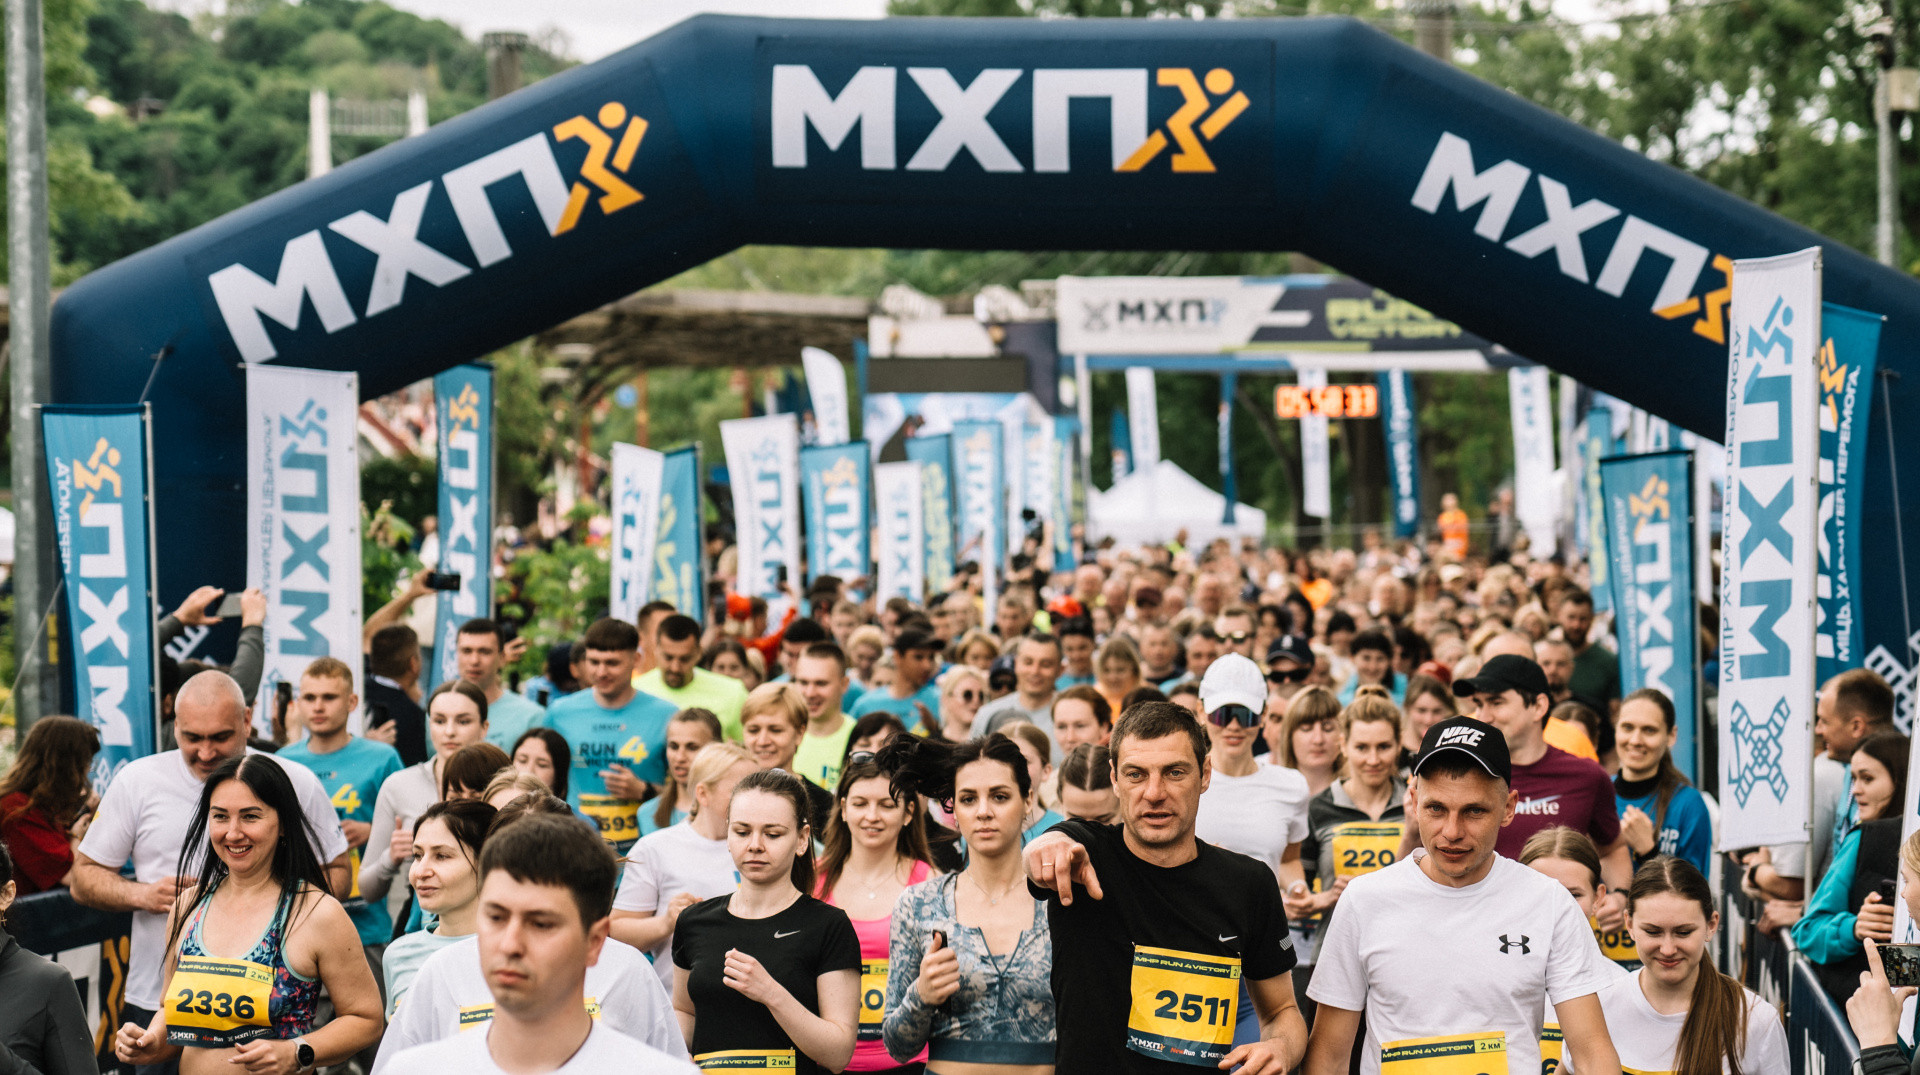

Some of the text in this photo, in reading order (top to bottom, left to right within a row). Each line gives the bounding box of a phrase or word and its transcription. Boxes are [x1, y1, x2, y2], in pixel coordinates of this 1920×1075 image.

[772, 65, 1148, 172] МХП
[1410, 131, 1710, 313] МХП
[209, 133, 572, 362] МХП
[1118, 299, 1206, 322] МХП
[1435, 726, 1485, 747] NIKE
[580, 736, 648, 764] RUN 4
[331, 783, 361, 814] 4
[176, 989, 255, 1019] 2336
[462, 1012, 486, 1020] MHP
[1154, 990, 1230, 1026] 2511
[1138, 1039, 1161, 1049] МХП
[1170, 1047, 1196, 1056] NewRun
[1402, 1049, 1423, 1057] RUN
[1481, 1042, 1486, 1050] 2
